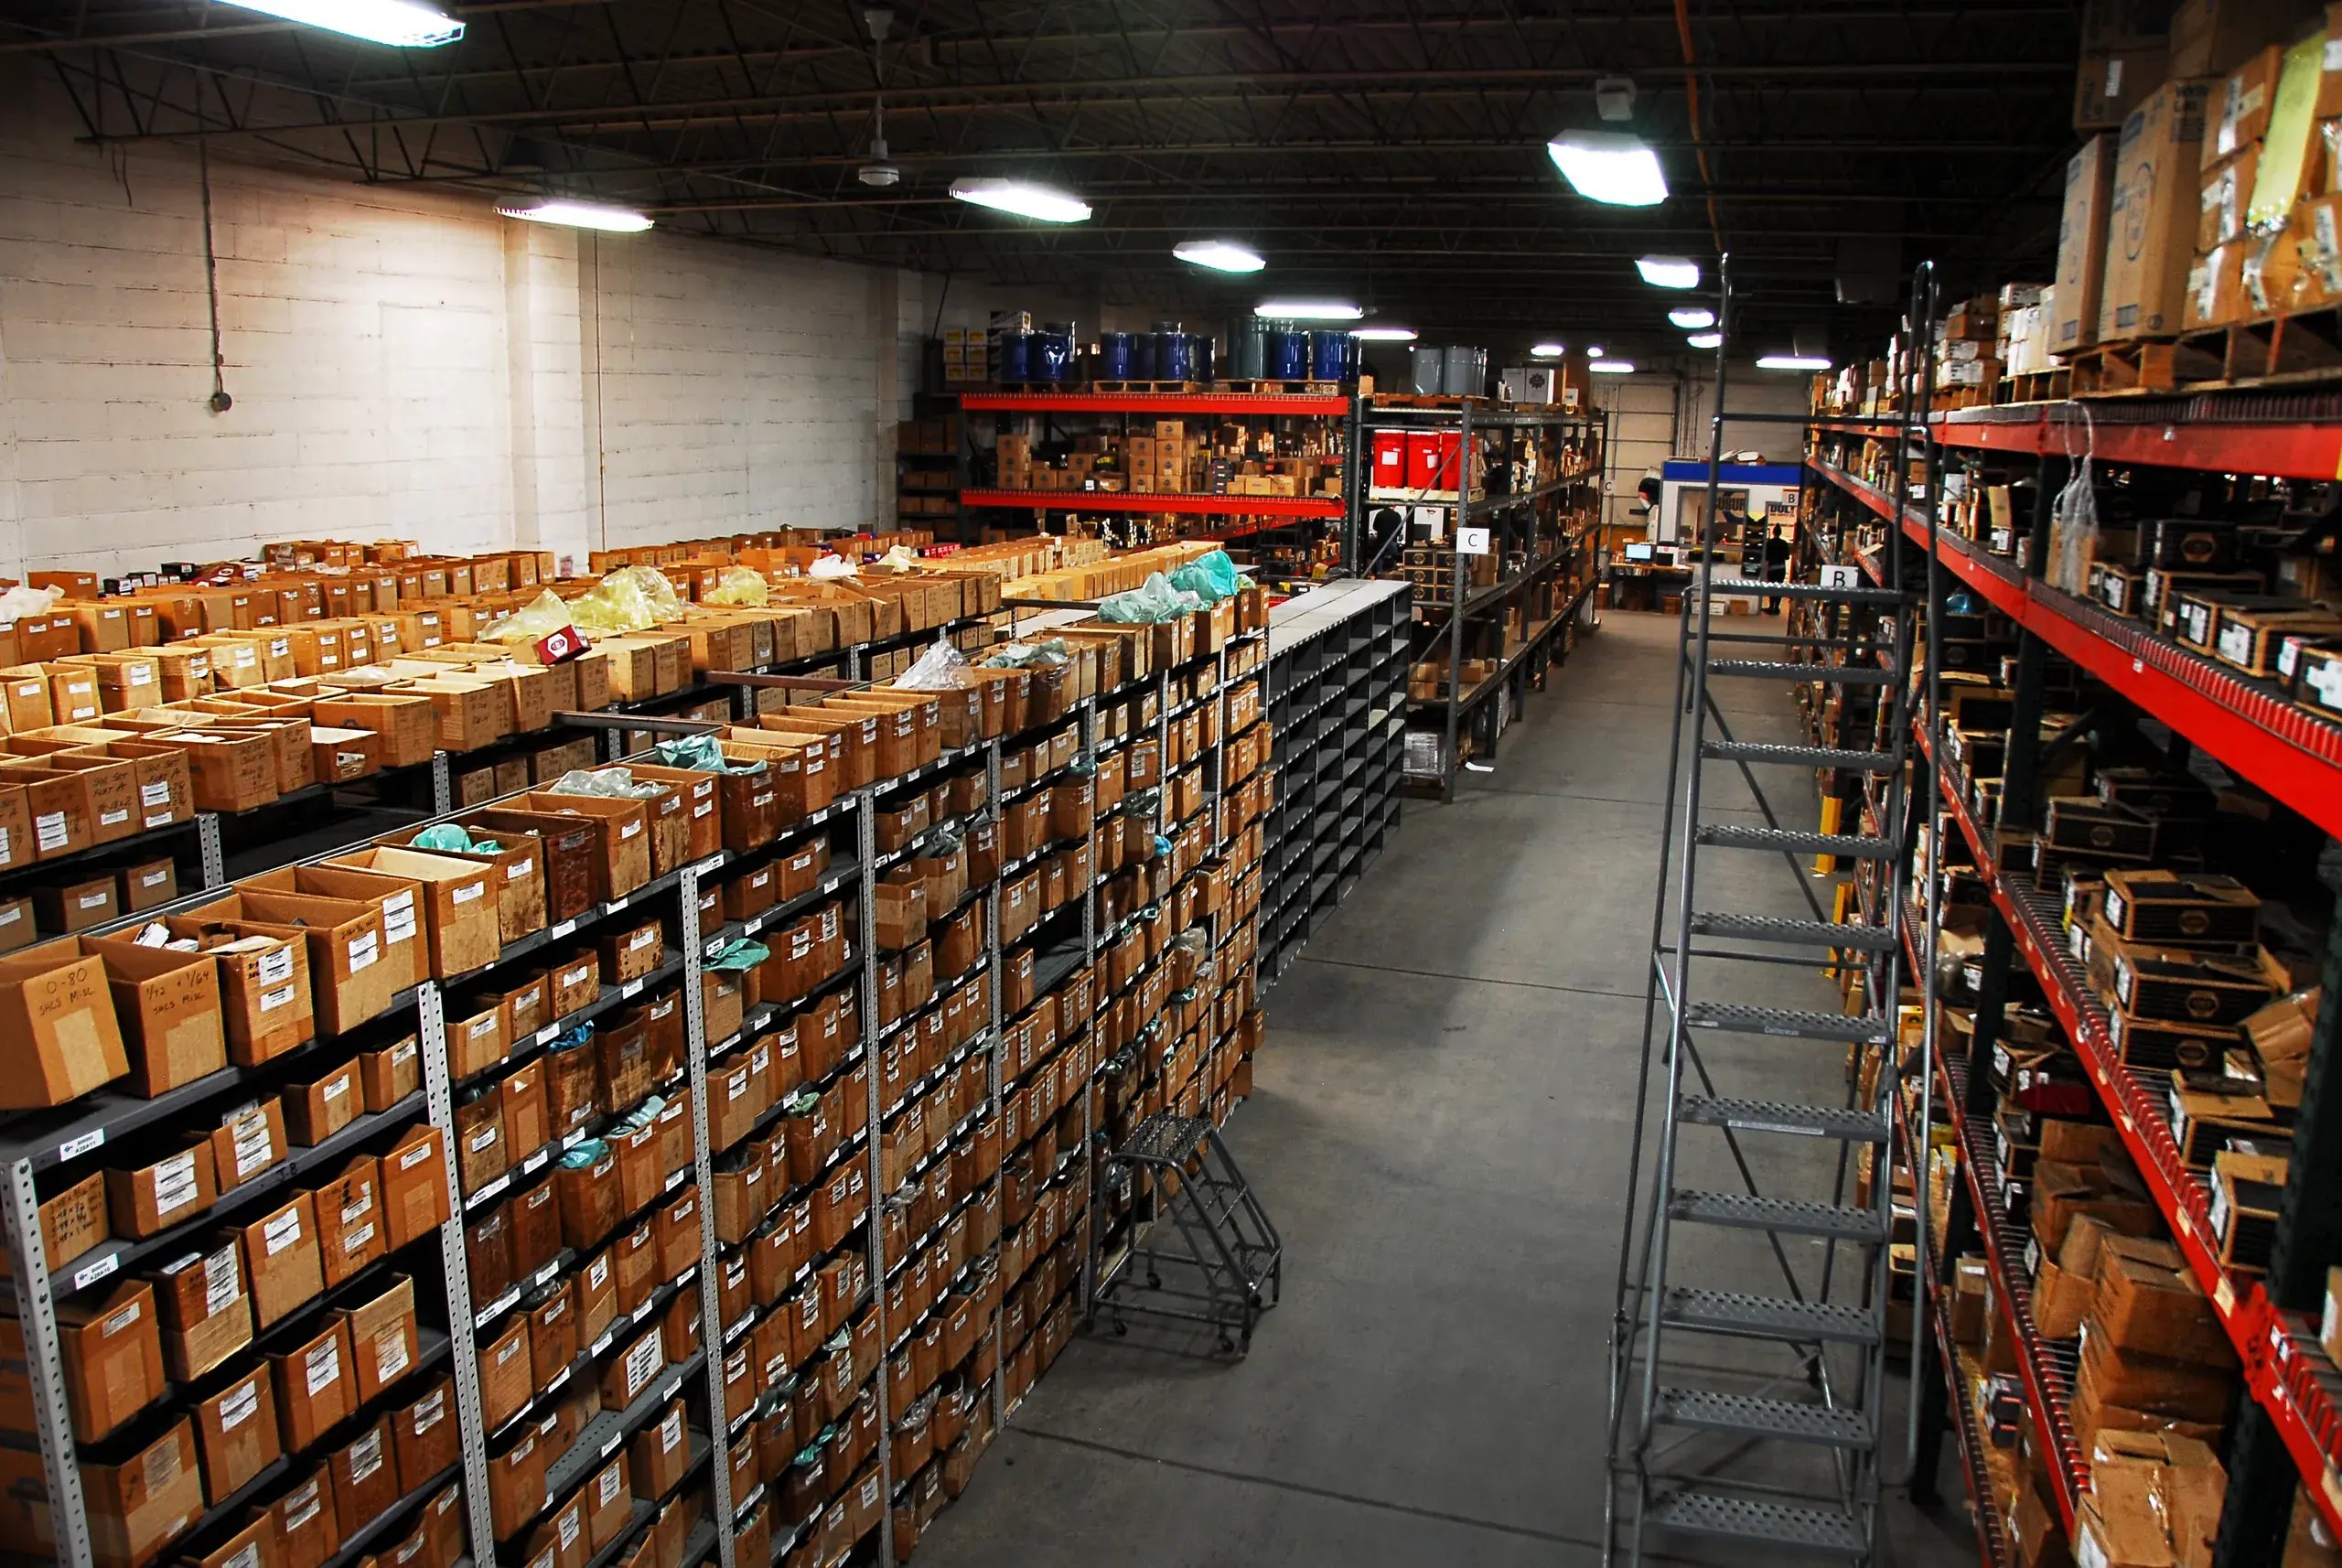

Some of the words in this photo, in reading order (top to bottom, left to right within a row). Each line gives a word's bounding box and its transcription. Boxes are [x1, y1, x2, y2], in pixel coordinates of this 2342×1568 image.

[1605, 481, 1612, 491] C
[1788, 493, 1795, 503] B
[1467, 533, 1478, 547] C
[1832, 570, 1846, 587] B
[46, 967, 88, 994] 0-80
[186, 970, 209, 988] 1/64
